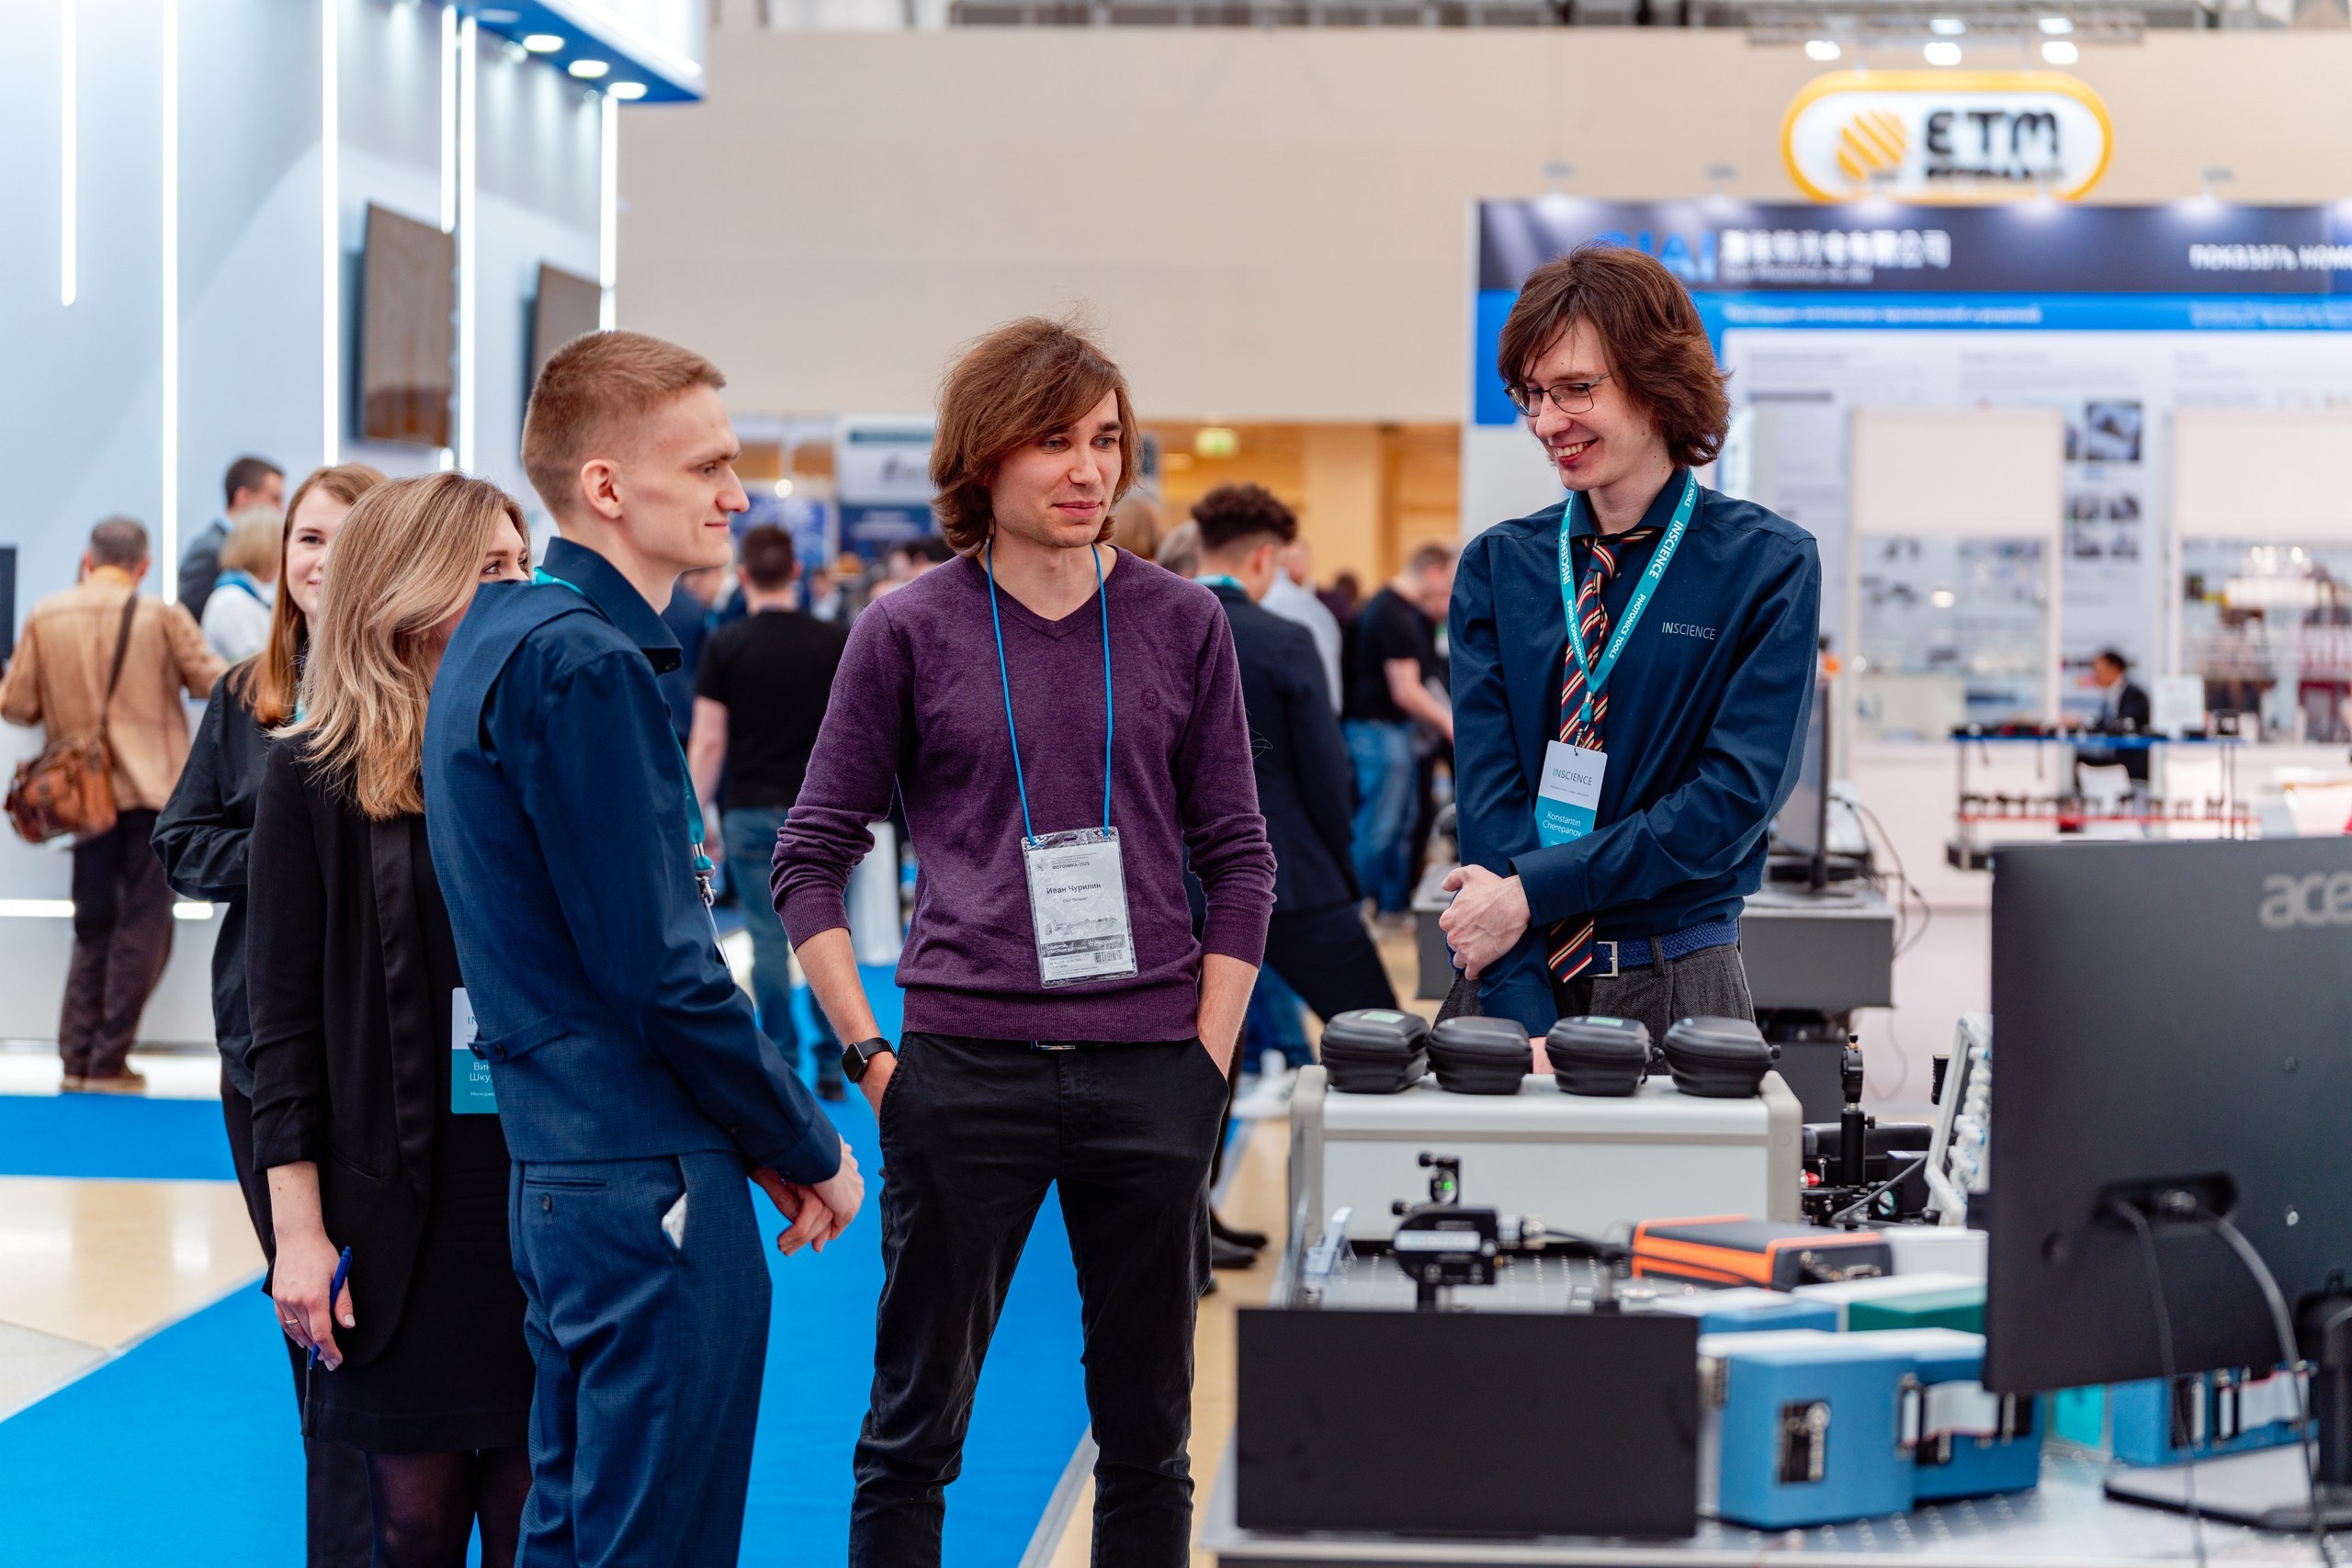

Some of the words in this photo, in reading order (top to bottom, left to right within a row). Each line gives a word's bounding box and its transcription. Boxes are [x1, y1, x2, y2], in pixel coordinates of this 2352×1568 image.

[1561, 529, 1571, 585] INSCIENCE
[1648, 520, 1684, 580] INSCIENCE
[1566, 599, 1575, 623] TOOLS
[1621, 593, 1646, 636] PHOTONICS
[1661, 622, 1716, 640] INSCIENCE
[1570, 622, 1584, 664] PHOTONICS
[1609, 636, 1624, 660] TOOLS
[1552, 768, 1593, 786] INSCIENCE
[1543, 819, 1582, 837] Cherepanov
[1547, 810, 1581, 827] Konstantin
[1046, 886, 1067, 895] Иван
[1068, 883, 1102, 894] Чурилин
[469, 1072, 493, 1083] Шку
